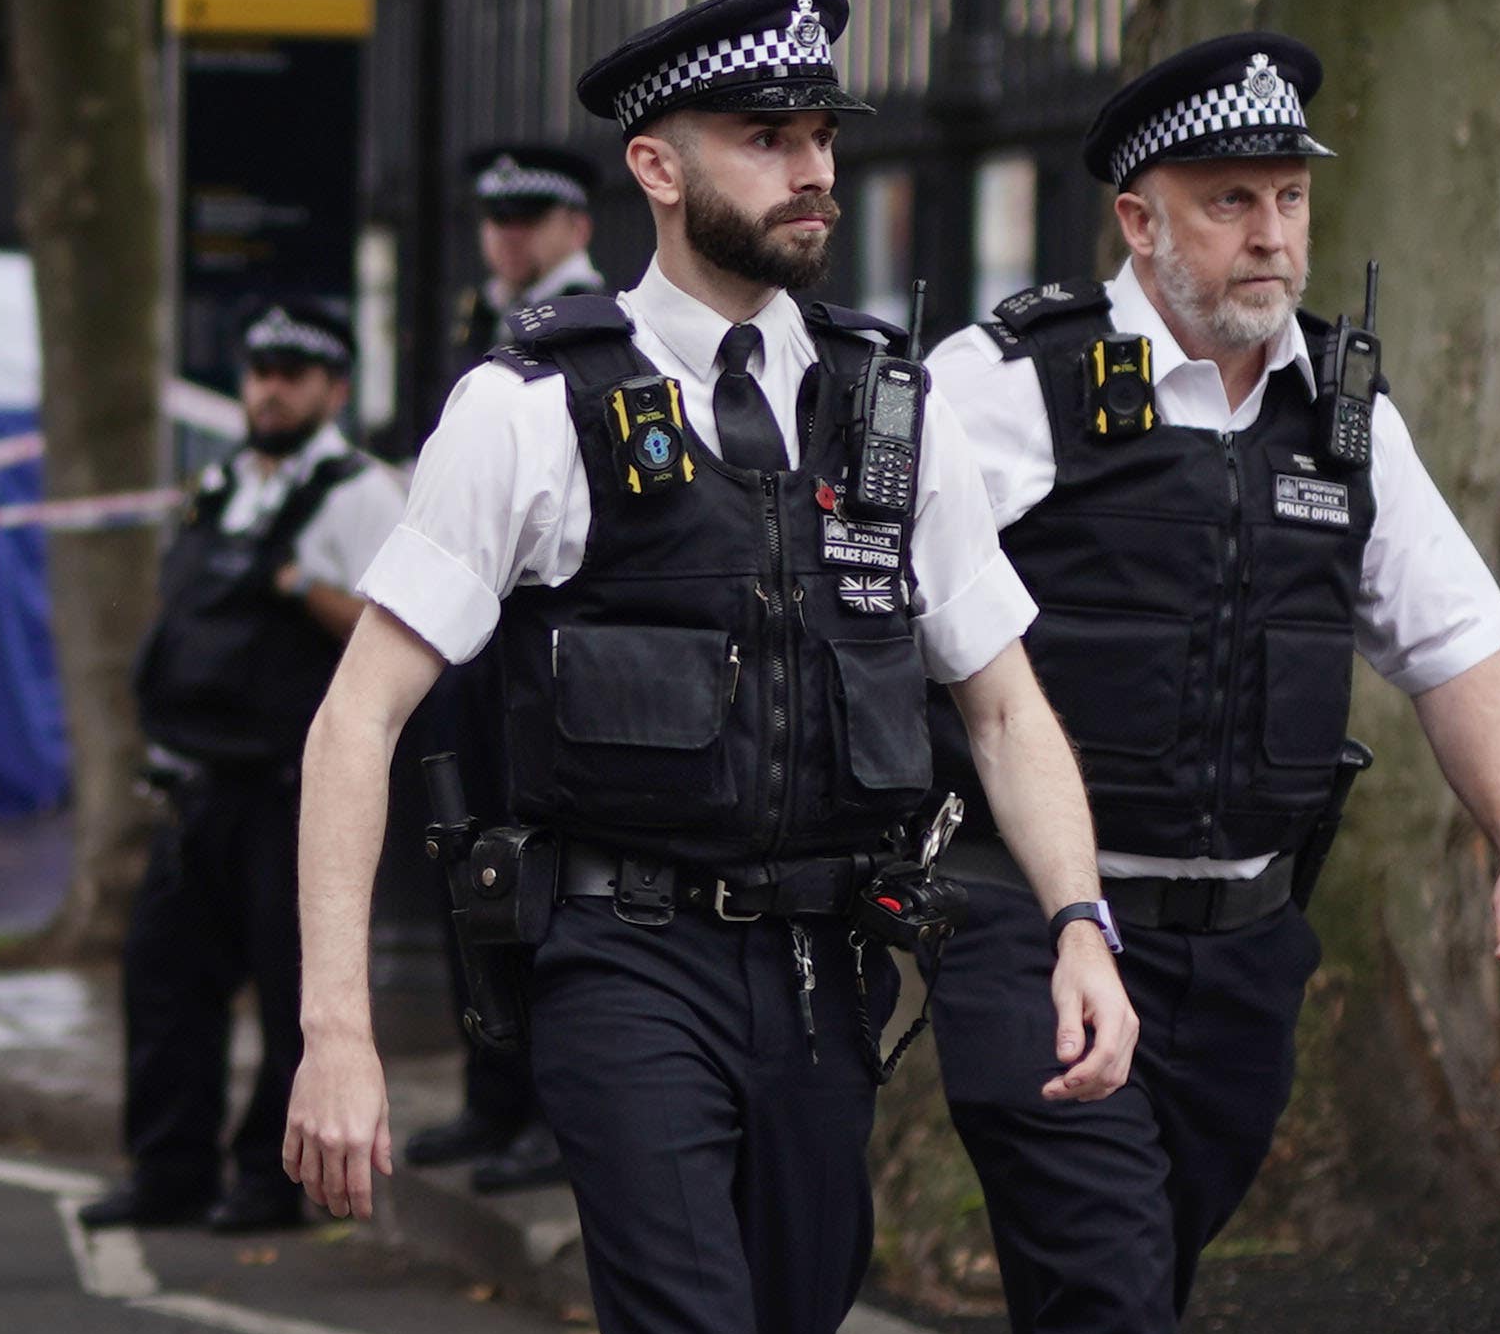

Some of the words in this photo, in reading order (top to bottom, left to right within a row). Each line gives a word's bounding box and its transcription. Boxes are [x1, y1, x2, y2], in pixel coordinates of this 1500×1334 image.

[1304, 492, 1339, 505] POLICE
[1277, 501, 1310, 519] POLICE
[1311, 506, 1350, 524] OFFICER
[854, 533, 891, 547] POLICE
[824, 545, 861, 562] POLICE
[861, 549, 899, 568] OFFICER
